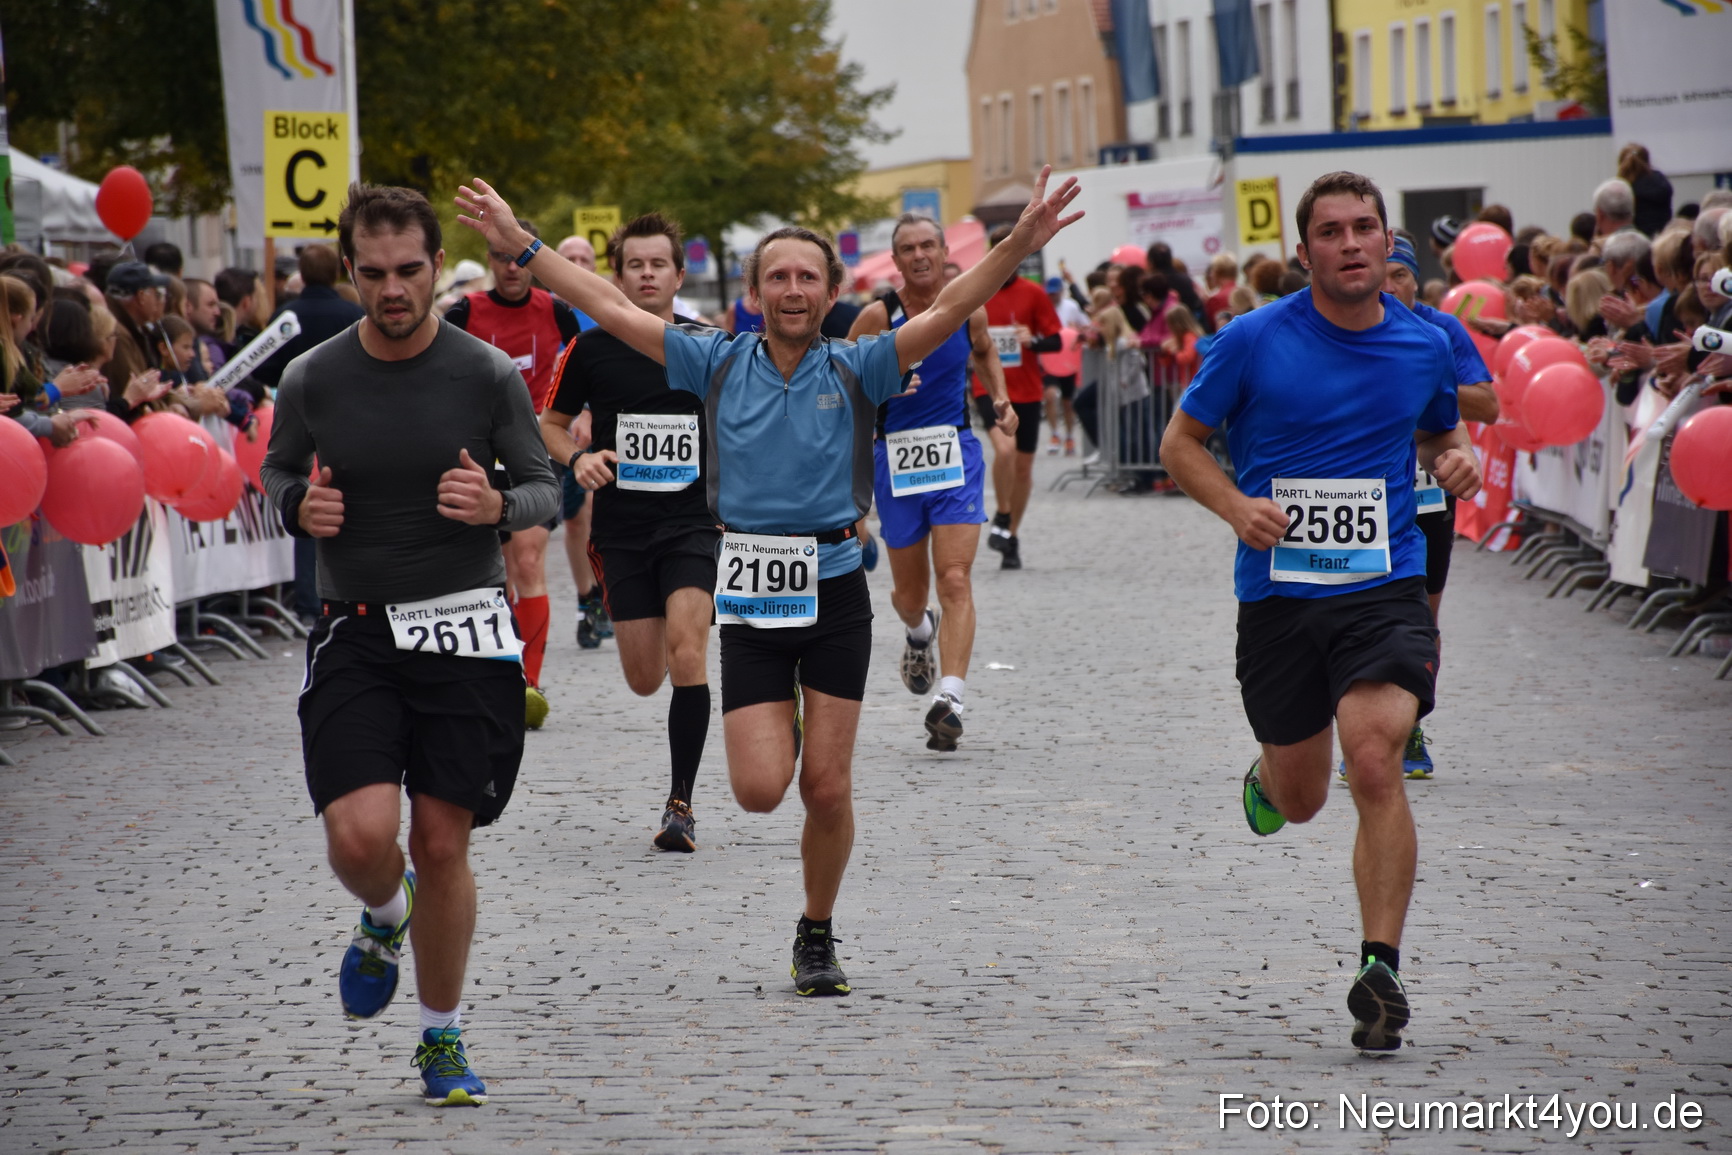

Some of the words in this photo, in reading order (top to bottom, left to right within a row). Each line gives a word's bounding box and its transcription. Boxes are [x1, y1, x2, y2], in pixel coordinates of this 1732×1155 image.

[273, 115, 339, 140] Block
[285, 149, 327, 211] C
[1249, 198, 1272, 230] D
[588, 228, 609, 259] D
[619, 420, 646, 430] PARTL
[647, 422, 686, 430] Neumarkt
[624, 432, 693, 462] 3046
[888, 437, 912, 446] PARTL
[912, 432, 946, 443] Neumarkt
[896, 441, 953, 471] 2267
[909, 471, 947, 486] Gerhard
[1275, 488, 1312, 499] PARTL
[1314, 489, 1368, 500] Neumarkt
[1283, 504, 1378, 544] 2585
[725, 541, 750, 553] PARTL
[752, 543, 799, 556] Neumarkt
[1309, 553, 1351, 570] Franz
[726, 556, 808, 593] 2190
[391, 608, 433, 622] PARTL
[434, 599, 492, 617] Neumarkt
[723, 599, 807, 618] Hans-Jürgen
[407, 612, 504, 656] 2611
